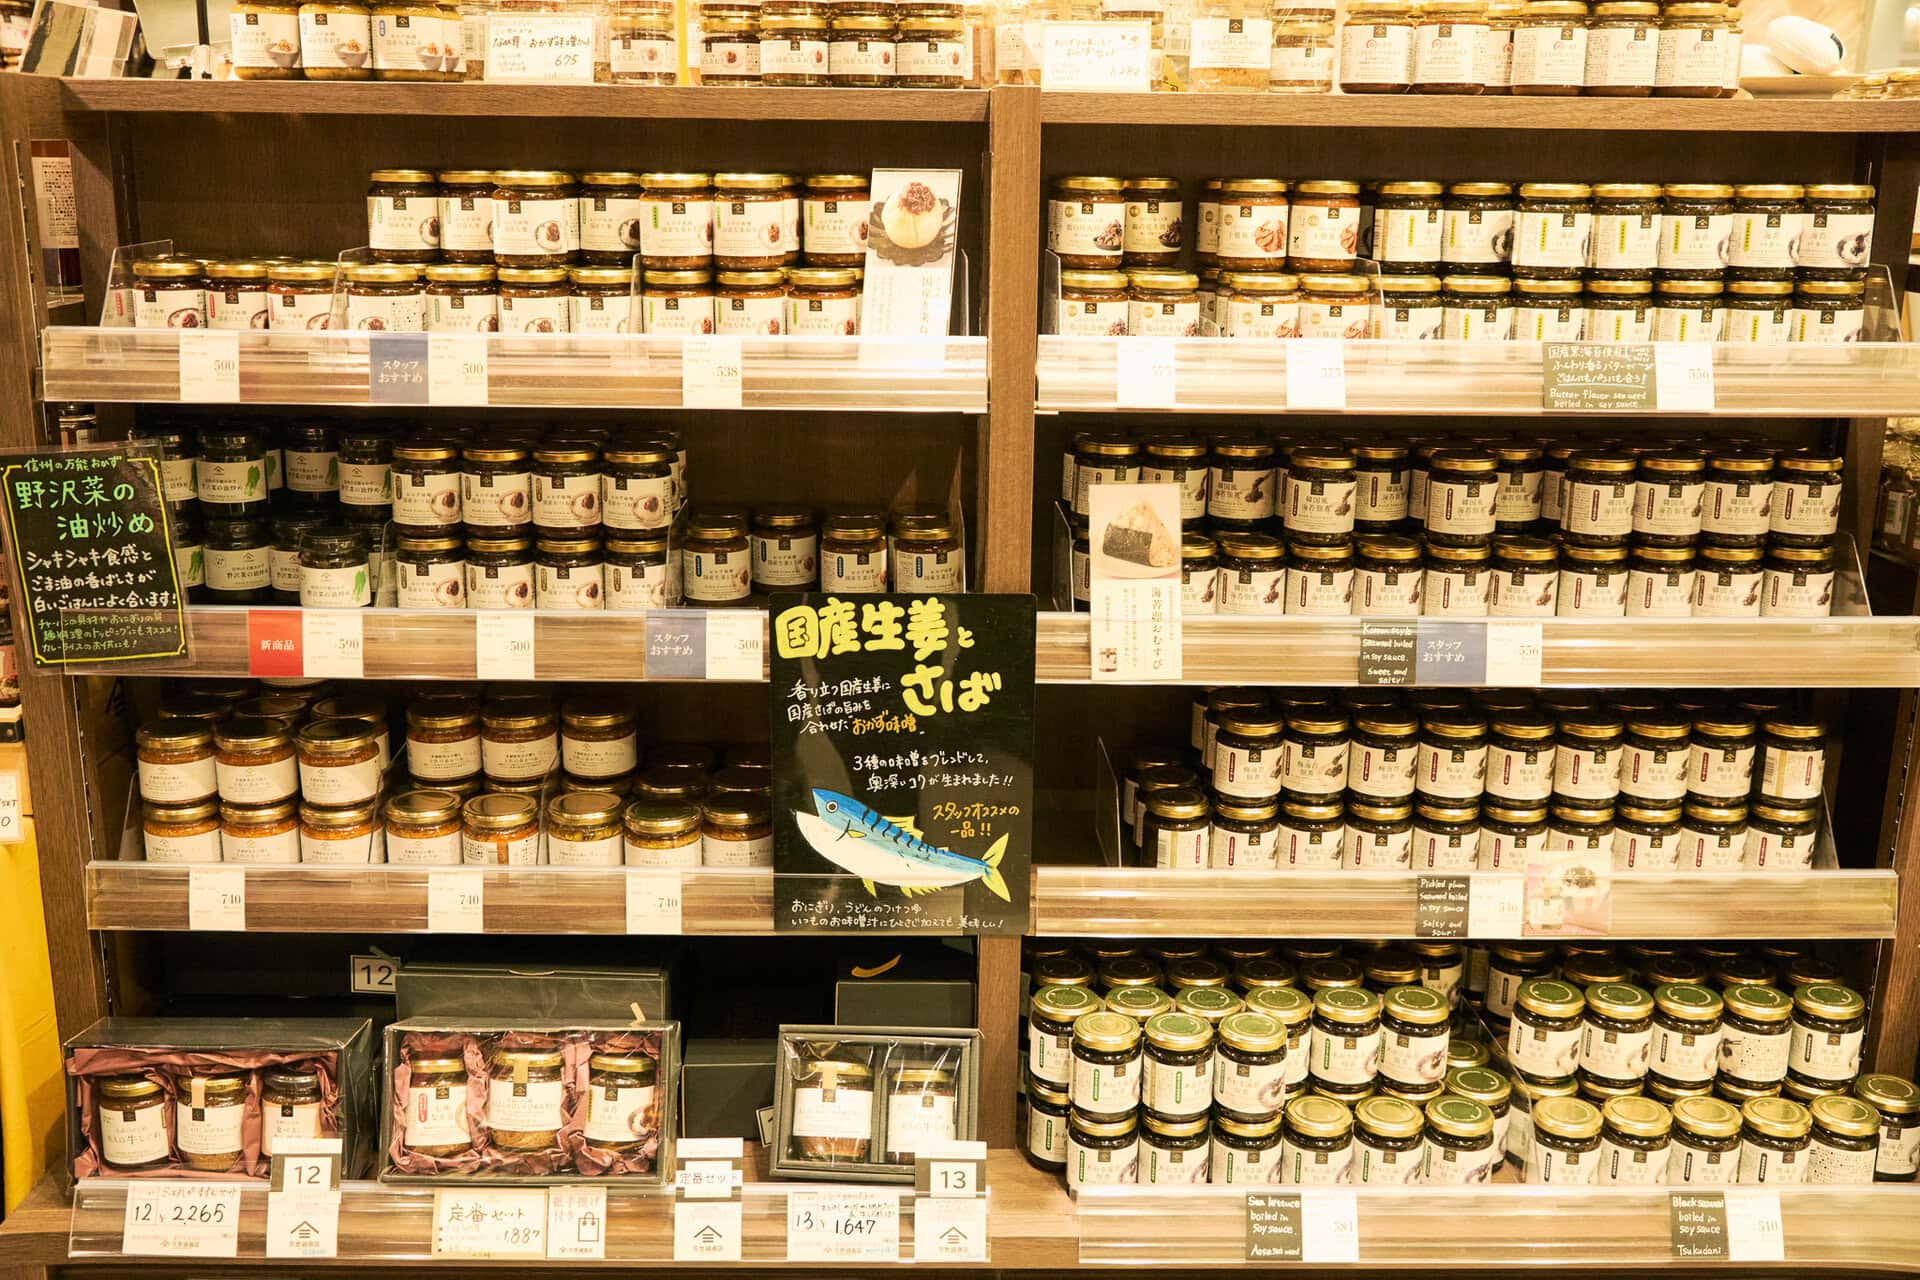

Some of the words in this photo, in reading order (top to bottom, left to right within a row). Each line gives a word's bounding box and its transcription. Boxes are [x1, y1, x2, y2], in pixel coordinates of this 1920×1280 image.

[555, 54, 579, 66] 675
[213, 359, 236, 372] 500
[383, 360, 419, 370] スタッフ
[463, 362, 484, 374] 500
[378, 372, 423, 384] おすすめ
[23, 456, 122, 473] 信州の万能おかず
[15, 475, 135, 510] 野沢菜の
[56, 512, 154, 540] 油炒め
[25, 543, 153, 571] シャキシャキ食感と
[31, 570, 157, 592] ごま油の香ばしさが
[34, 591, 178, 613] 白いごはんによく合います!
[775, 597, 975, 661] 国産生姜と
[338, 639, 359, 649] 590
[654, 633, 689, 643] スタッフ
[260, 639, 295, 651] 新商品
[510, 640, 530, 651] 500
[650, 645, 693, 656] おすすめ
[738, 640, 759, 650] 500
[1426, 640, 1463, 649] スタッフ
[1423, 652, 1465, 663] おすすめ
[1393, 667, 1408, 676] and
[786, 676, 892, 701] 香り立つ国産生姜に
[900, 663, 1002, 717] さば
[932, 802, 1021, 820] スタッフオススメの
[1420, 878, 1446, 888] Pickled
[222, 893, 242, 904] 740
[459, 894, 479, 905] 740
[658, 897, 678, 908] 740
[1449, 920, 1463, 929] and
[361, 964, 393, 986] 12
[294, 1166, 321, 1184] 12
[679, 1173, 738, 1185] 定番セット
[940, 1171, 966, 1189] 13
[1248, 1195, 1265, 1207] Sea
[1672, 1196, 1697, 1208] Black
[135, 1203, 151, 1222] 12
[449, 1202, 525, 1223] 定番セット
[1250, 1210, 1278, 1222] boiled
[1280, 1213, 1289, 1221] in
[1678, 1210, 1705, 1222] boiled
[796, 1211, 814, 1230] 13
[1696, 1225, 1721, 1234] sauce
